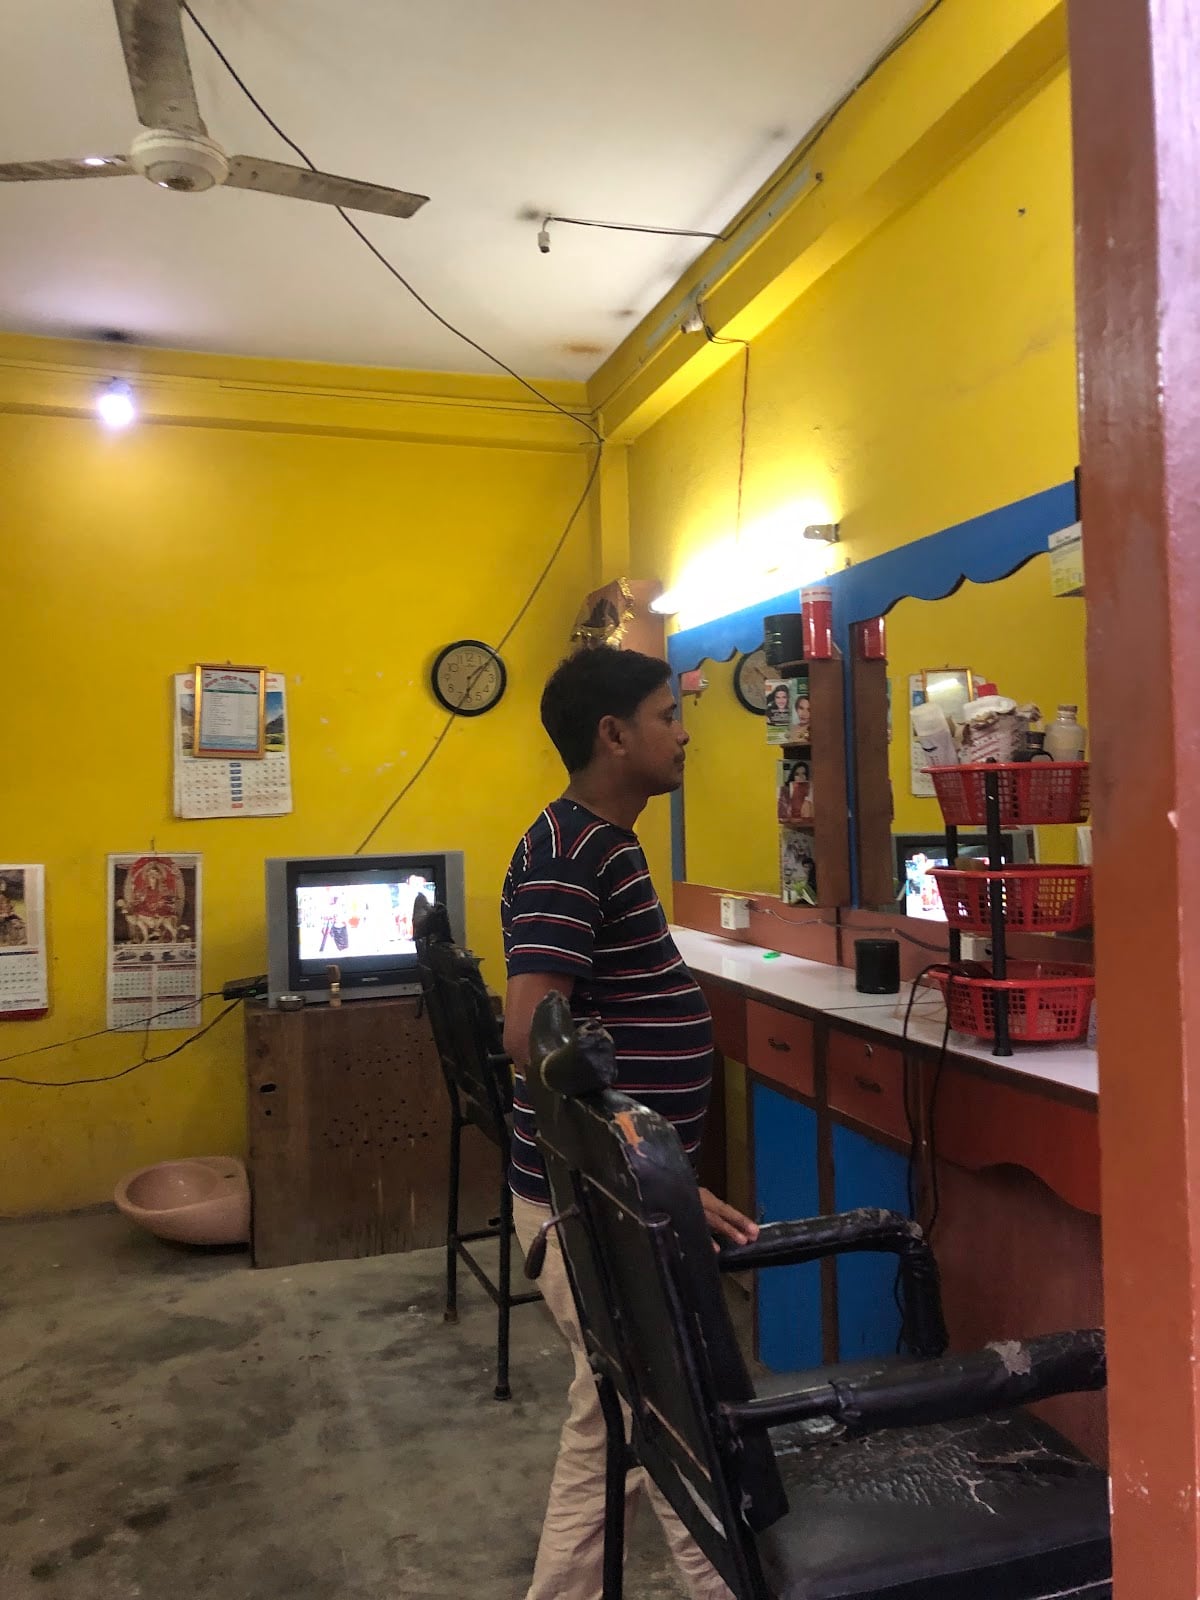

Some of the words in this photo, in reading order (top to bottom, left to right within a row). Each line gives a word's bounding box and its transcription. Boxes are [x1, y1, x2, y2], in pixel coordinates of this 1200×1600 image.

[464, 652, 474, 662] 12
[447, 662, 458, 672] 10
[488, 673, 494, 683] 3
[483, 684, 489, 692] 4
[475, 691, 482, 701] 5
